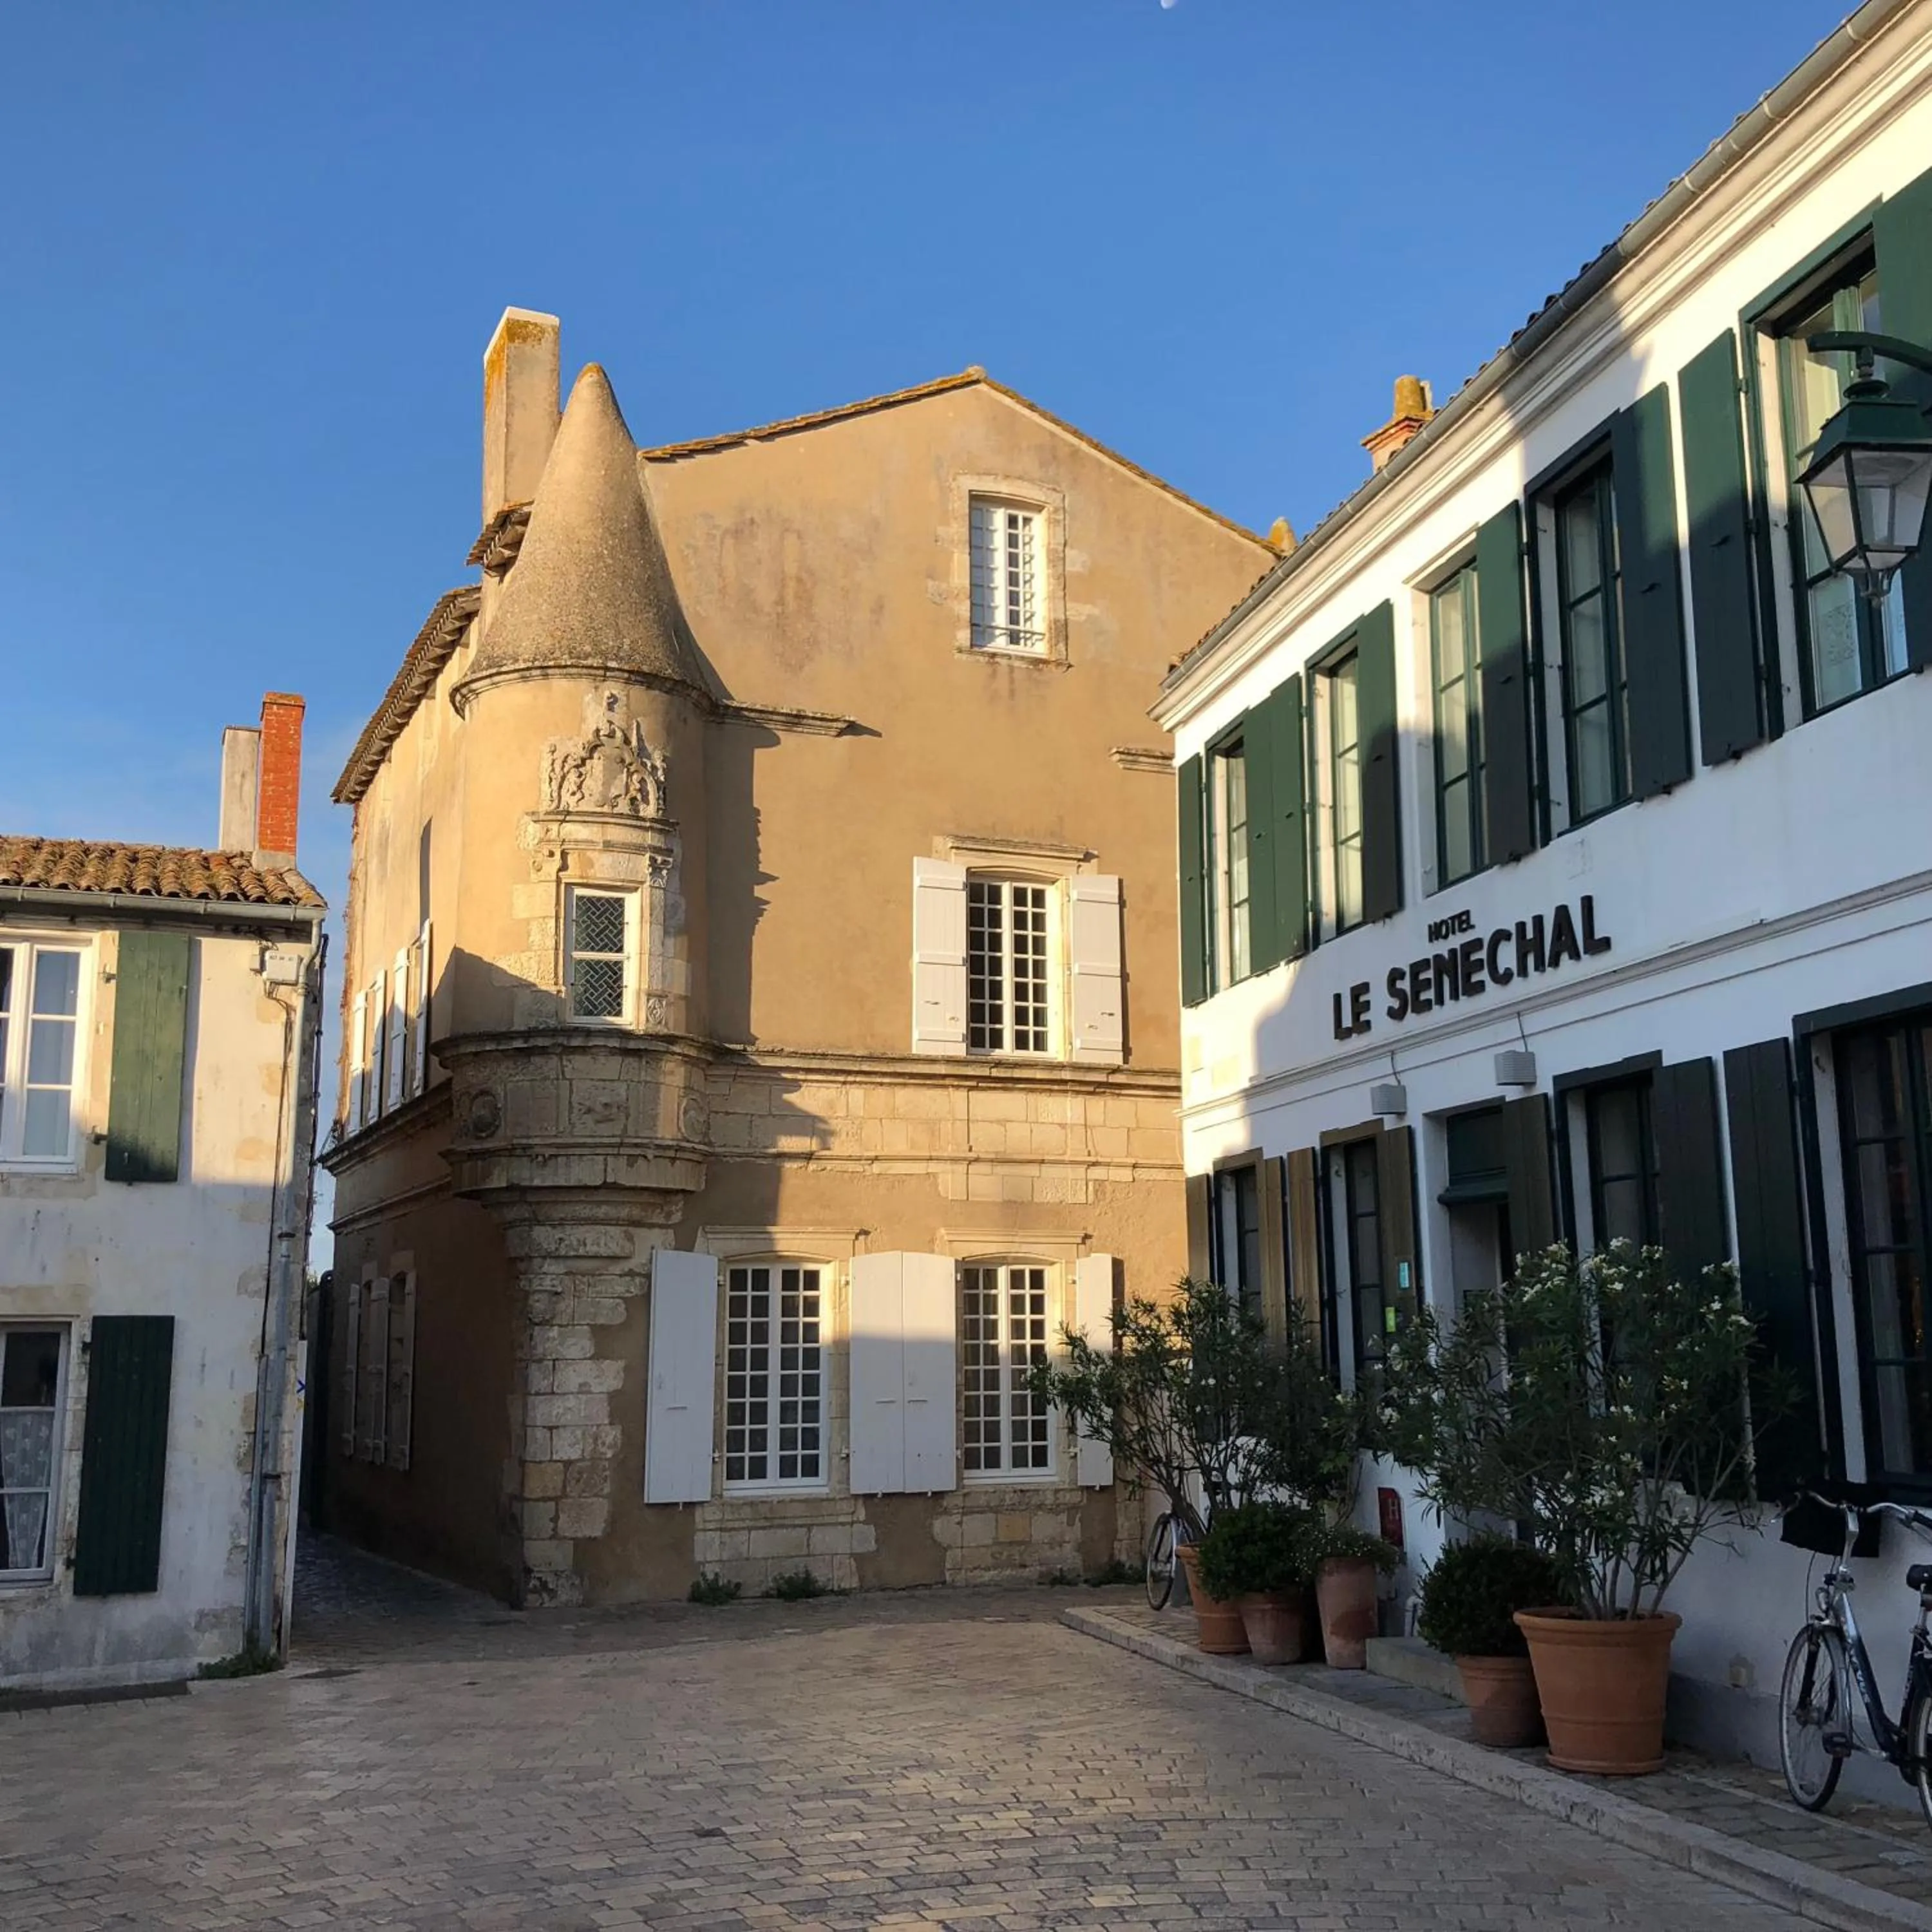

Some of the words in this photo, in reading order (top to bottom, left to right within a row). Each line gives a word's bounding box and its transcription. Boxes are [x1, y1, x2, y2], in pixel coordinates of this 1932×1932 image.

[1333, 981, 1371, 1040] LE
[1387, 895, 1611, 1021] SENECHAL
[1428, 909, 1475, 943] HOTEL
